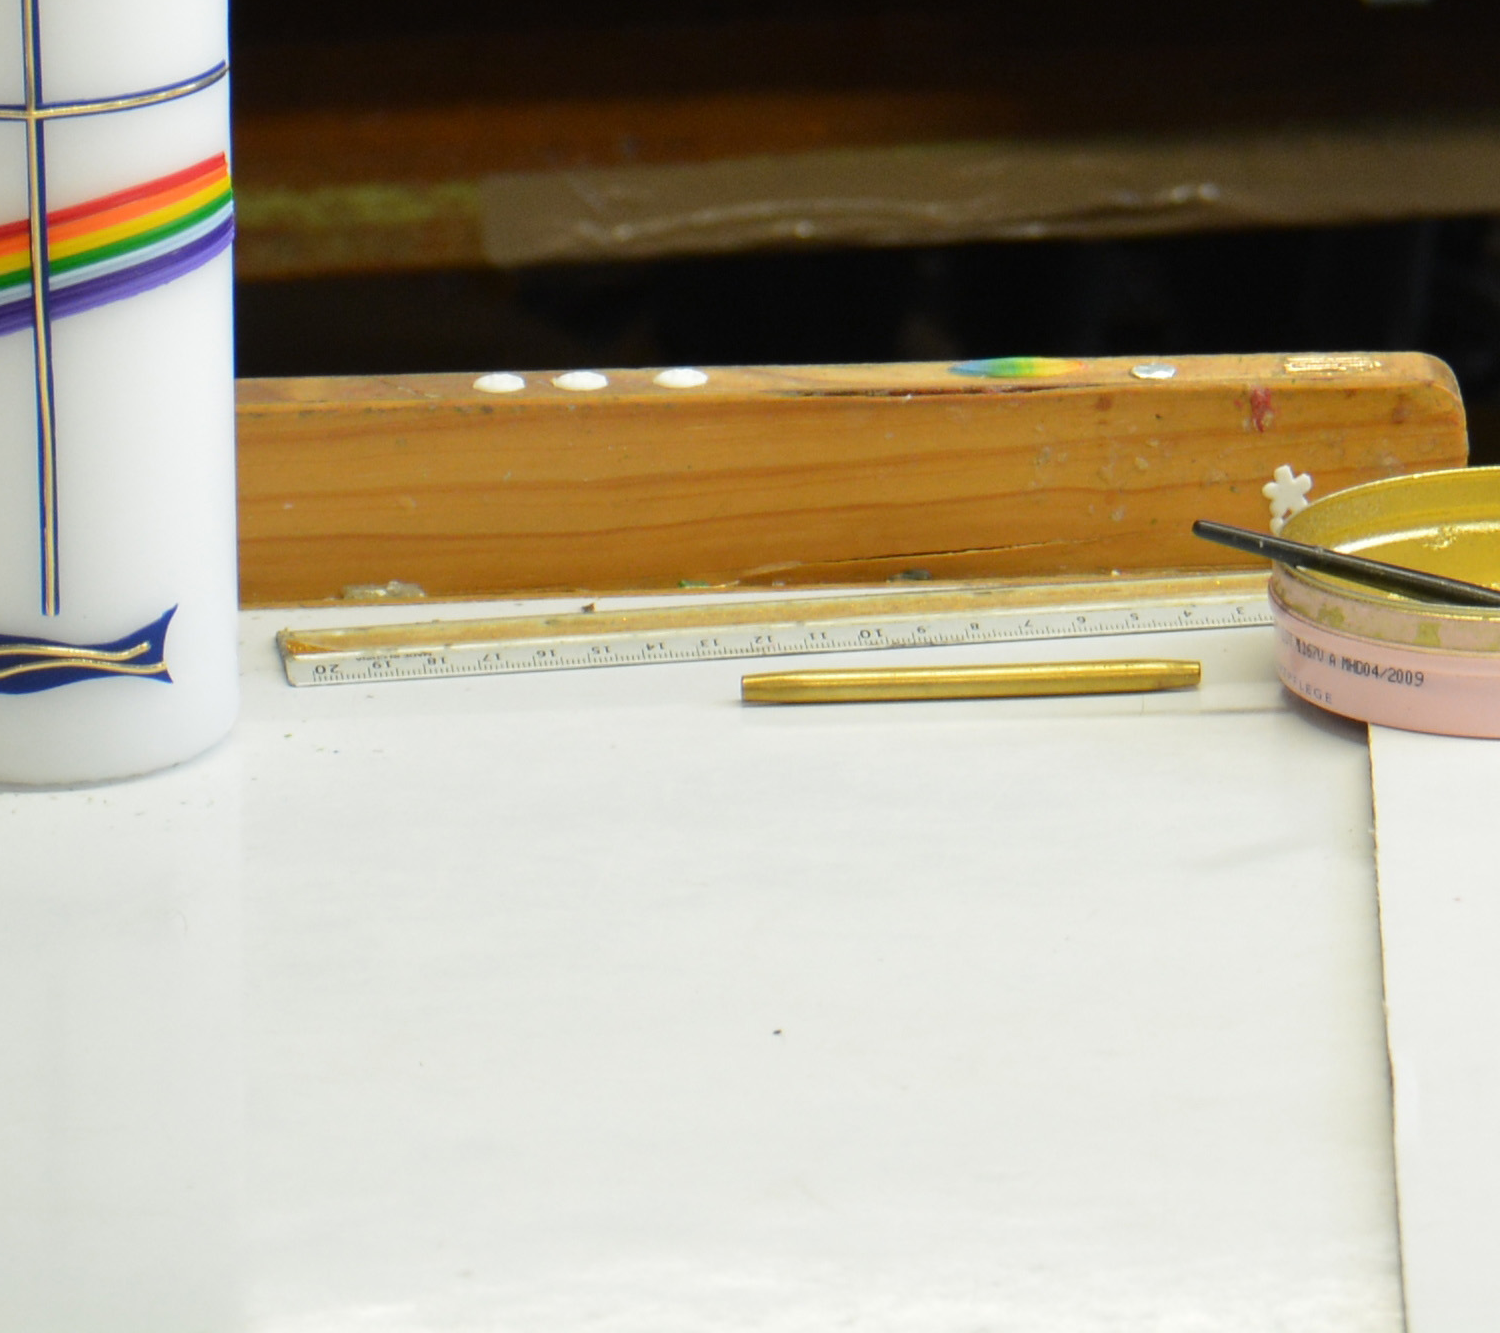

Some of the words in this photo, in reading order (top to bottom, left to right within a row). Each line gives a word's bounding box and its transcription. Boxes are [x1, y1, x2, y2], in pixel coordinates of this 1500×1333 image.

[1183, 609, 1193, 618] 4
[1236, 606, 1244, 615] 3
[1076, 615, 1086, 624] 6
[1130, 612, 1139, 621] 5
[970, 623, 980, 631] 8
[1024, 619, 1033, 628] 7
[859, 628, 883, 638] 10
[916, 626, 926, 635] 9
[754, 635, 773, 644] 12
[808, 632, 827, 640] 11
[646, 642, 665, 651] 14
[700, 638, 719, 647] 13
[591, 645, 610, 654] 15
[482, 653, 501, 662] 17
[536, 650, 556, 659] 16
[372, 660, 391, 670] 19
[427, 656, 446, 665] 18
[314, 664, 339, 675] 20
